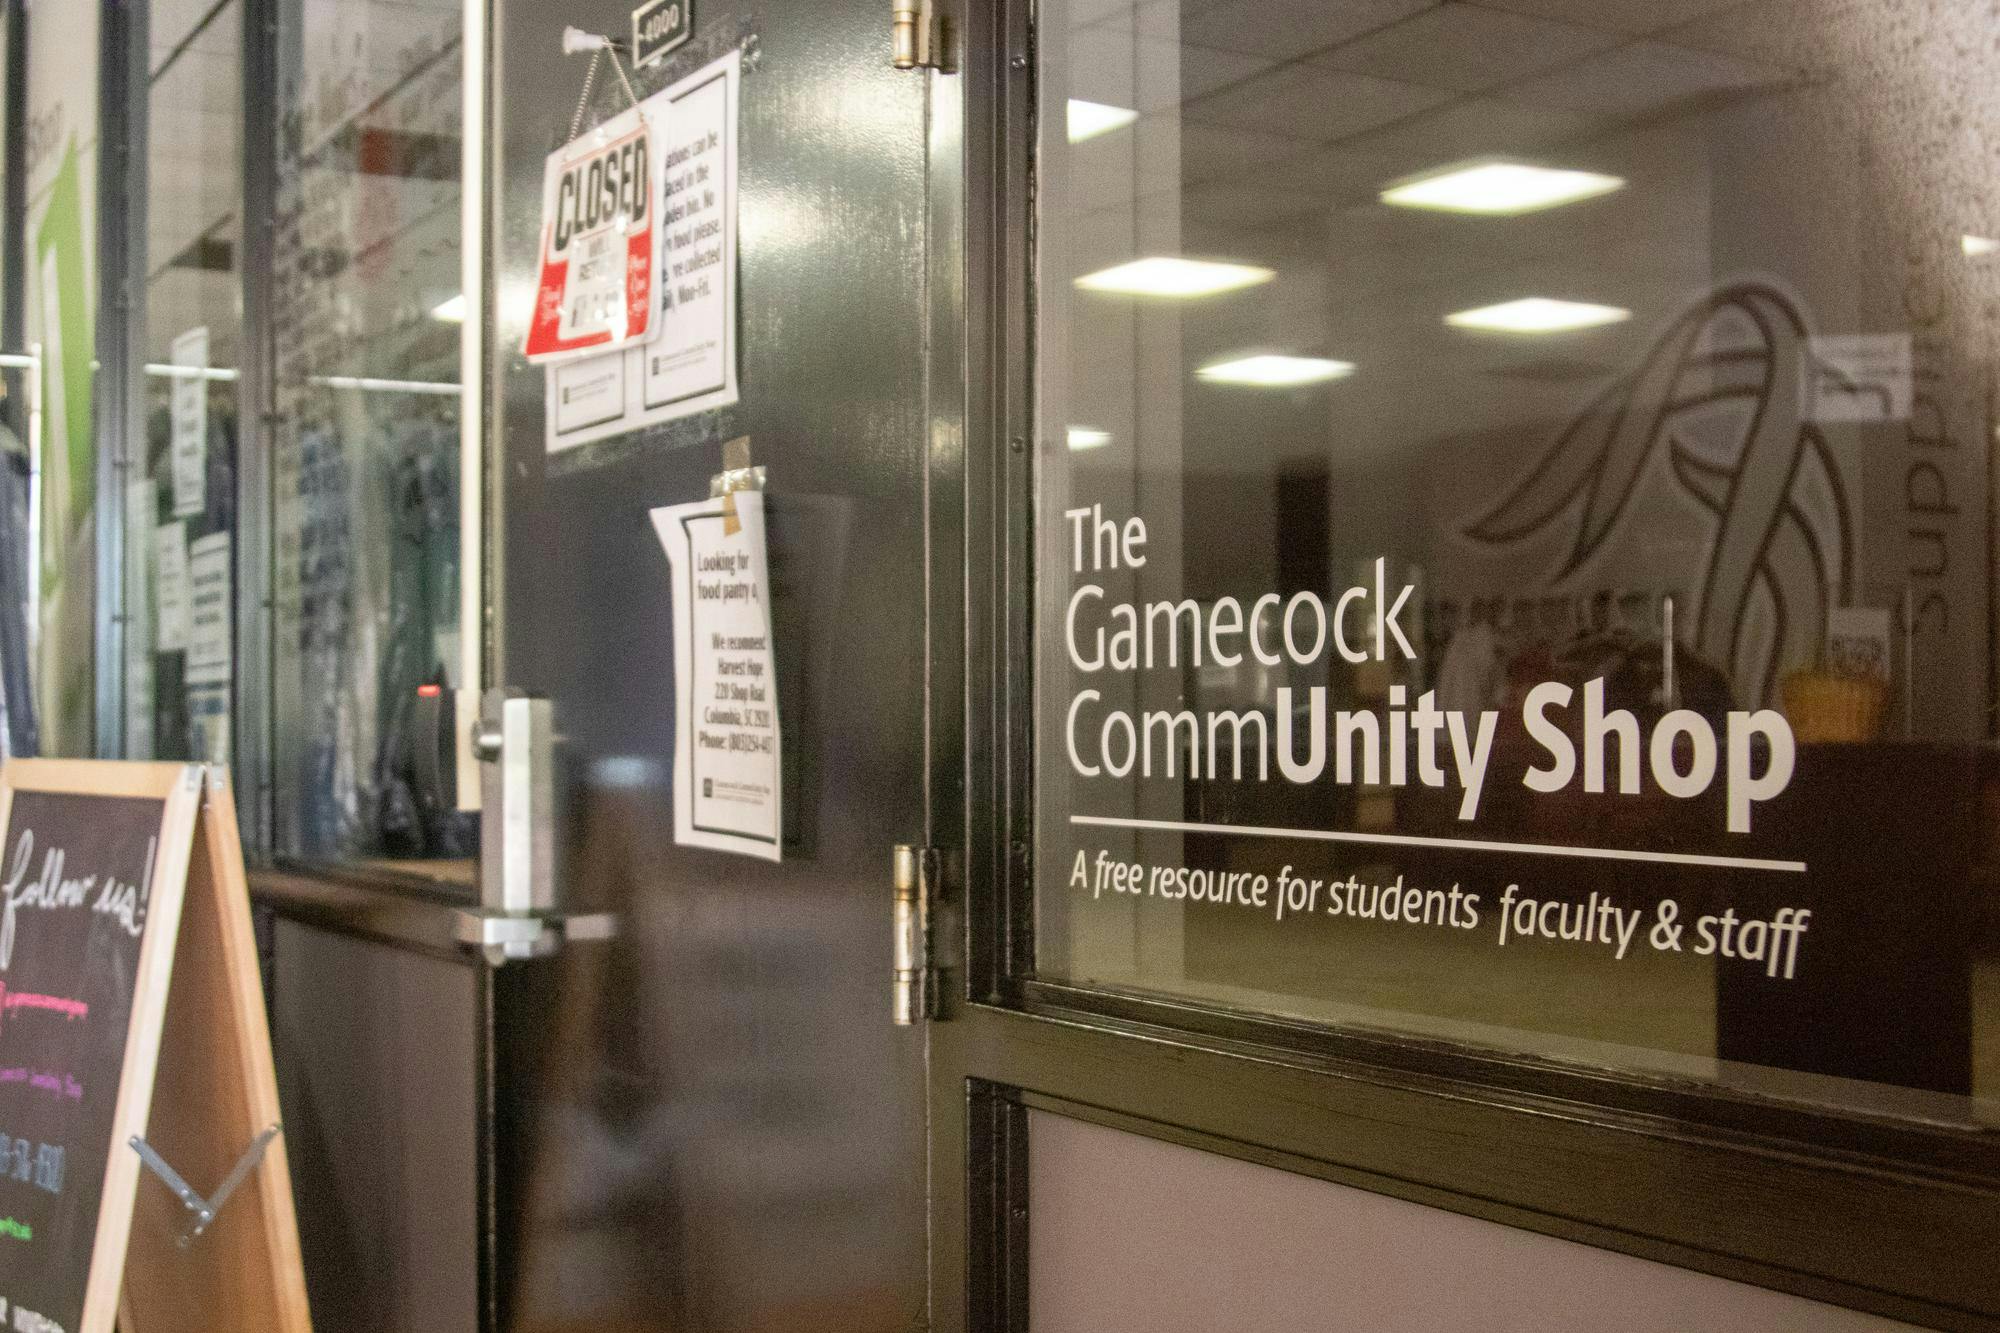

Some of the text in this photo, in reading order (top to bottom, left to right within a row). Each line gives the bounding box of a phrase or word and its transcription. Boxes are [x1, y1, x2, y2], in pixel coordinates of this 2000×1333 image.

[555, 135, 648, 251] CLOSED
[697, 549, 749, 576] Looking for
[697, 579, 720, 600] food
[1066, 503, 1147, 572] The
[1066, 556, 1417, 672] Gamecock
[1066, 676, 1796, 833] CommUnity Shop
[0, 828, 98, 971] follow
[1070, 850, 1812, 980] A free resource for students faculty & staff
